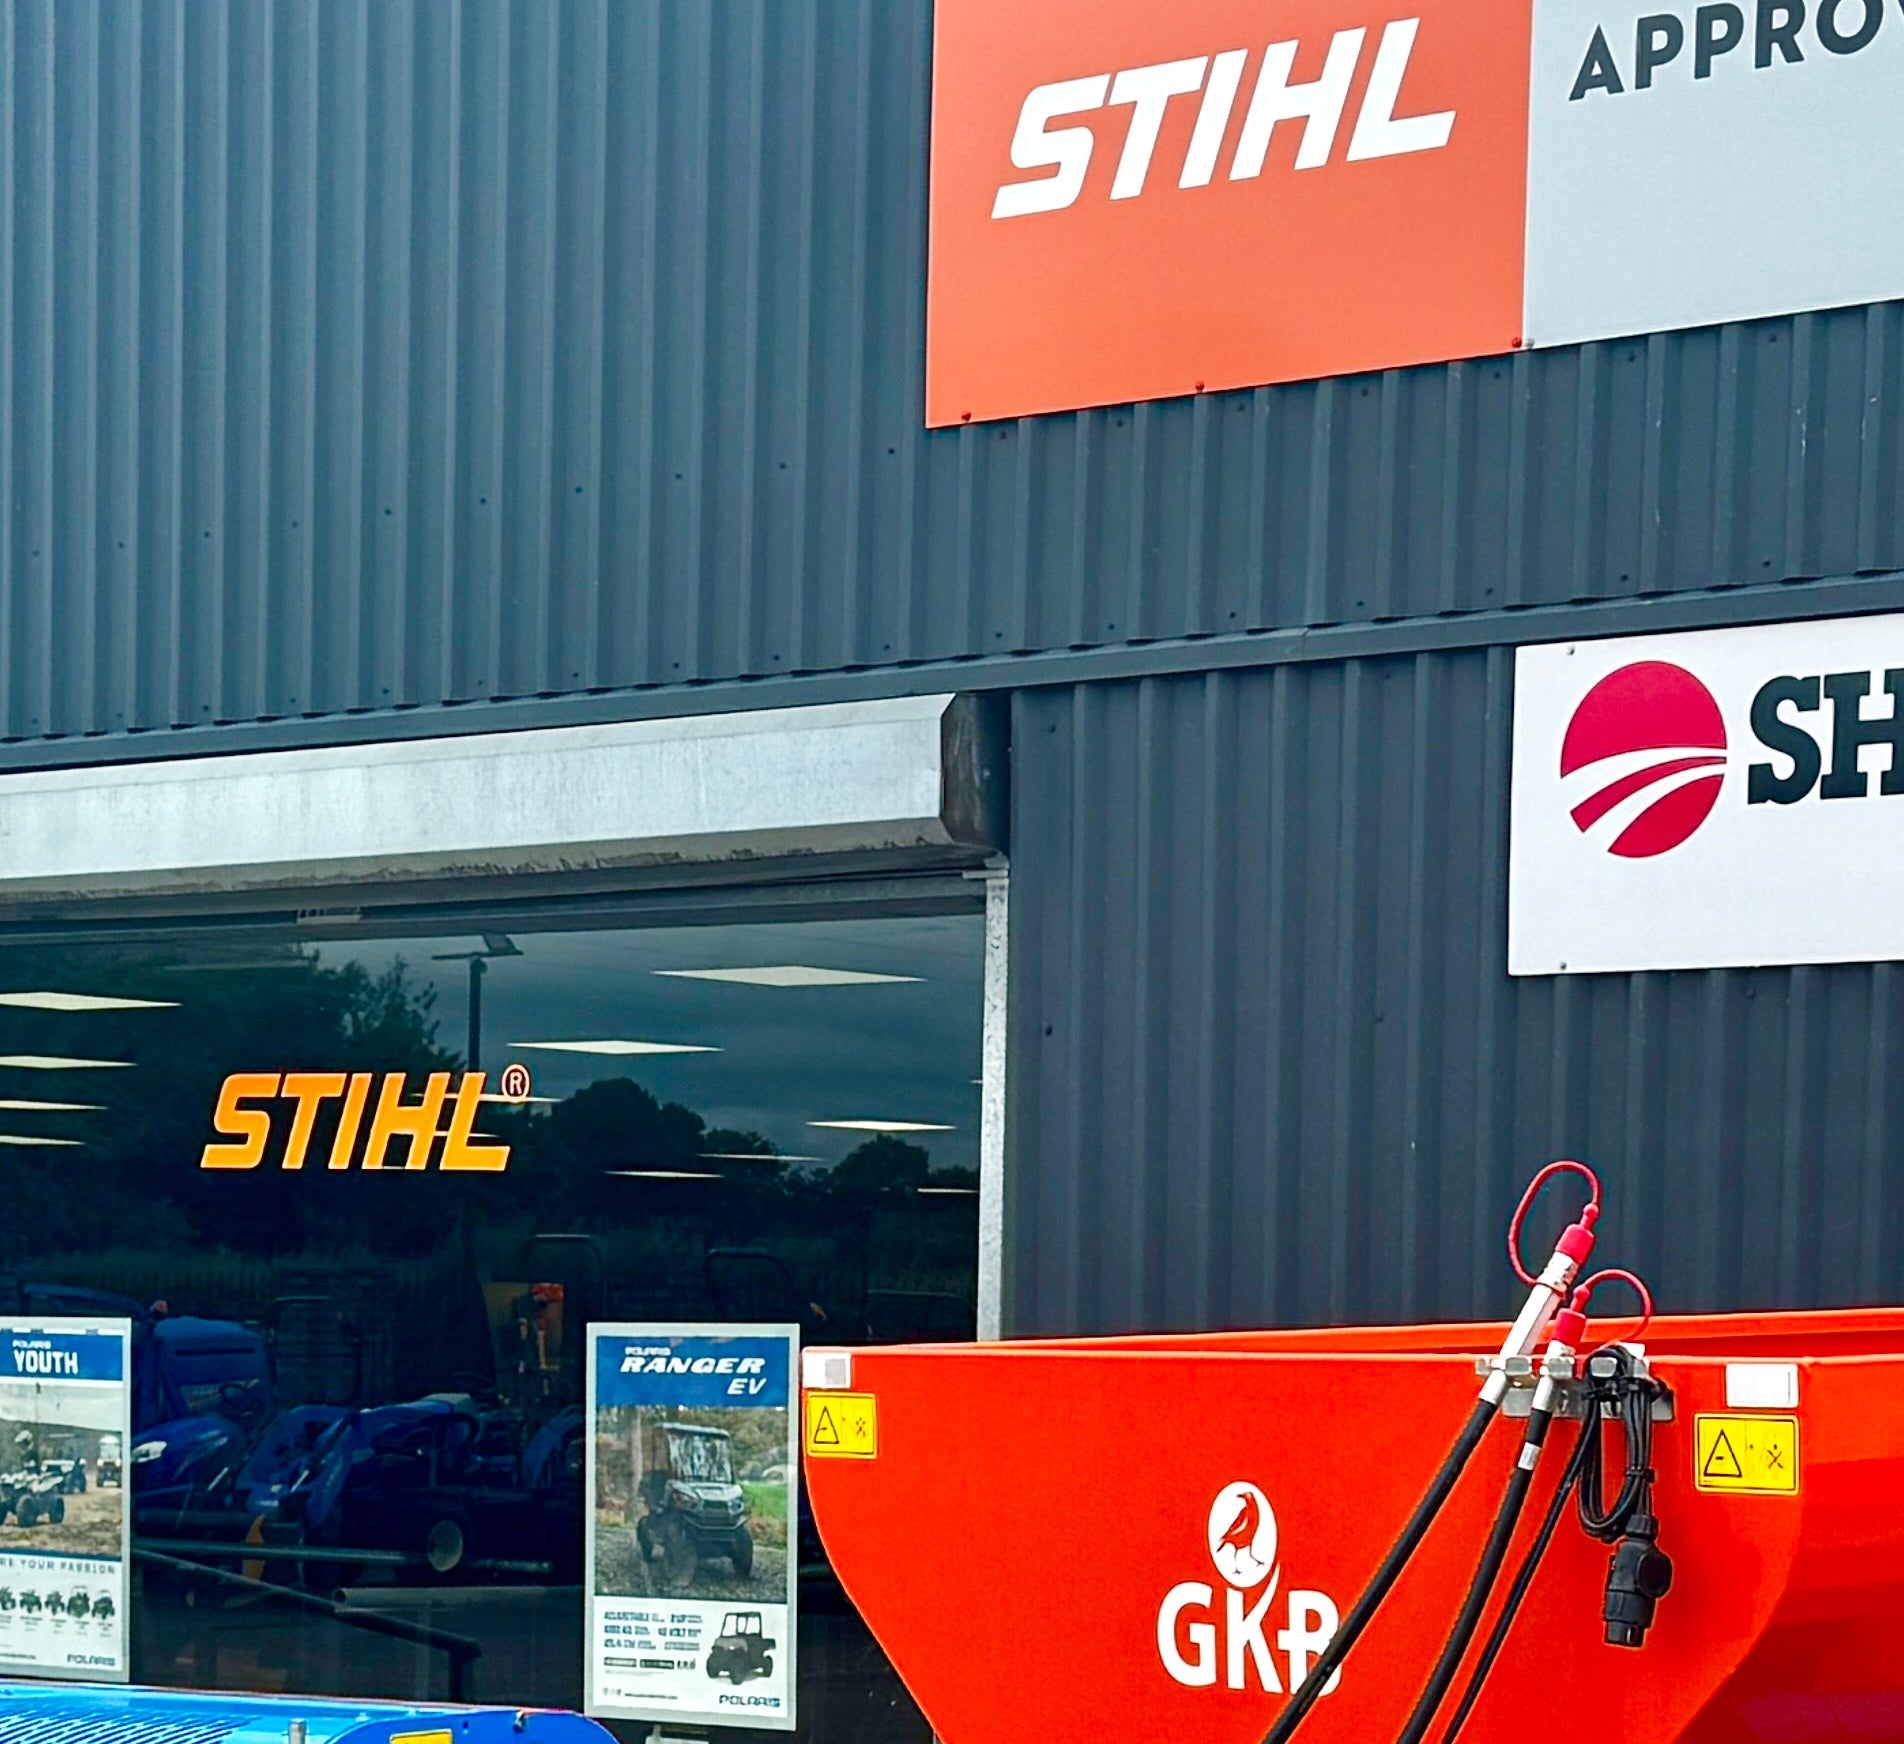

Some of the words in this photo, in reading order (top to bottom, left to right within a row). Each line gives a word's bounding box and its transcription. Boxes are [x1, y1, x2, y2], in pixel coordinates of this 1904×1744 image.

[991, 18, 1455, 219] STIHL
[14, 1350, 79, 1375] YOUTH
[620, 1357, 766, 1374] RANGER
[727, 1378, 767, 1395] EV
[1157, 1563, 1343, 1697] GKB
[719, 1695, 781, 1708] POLARIS
